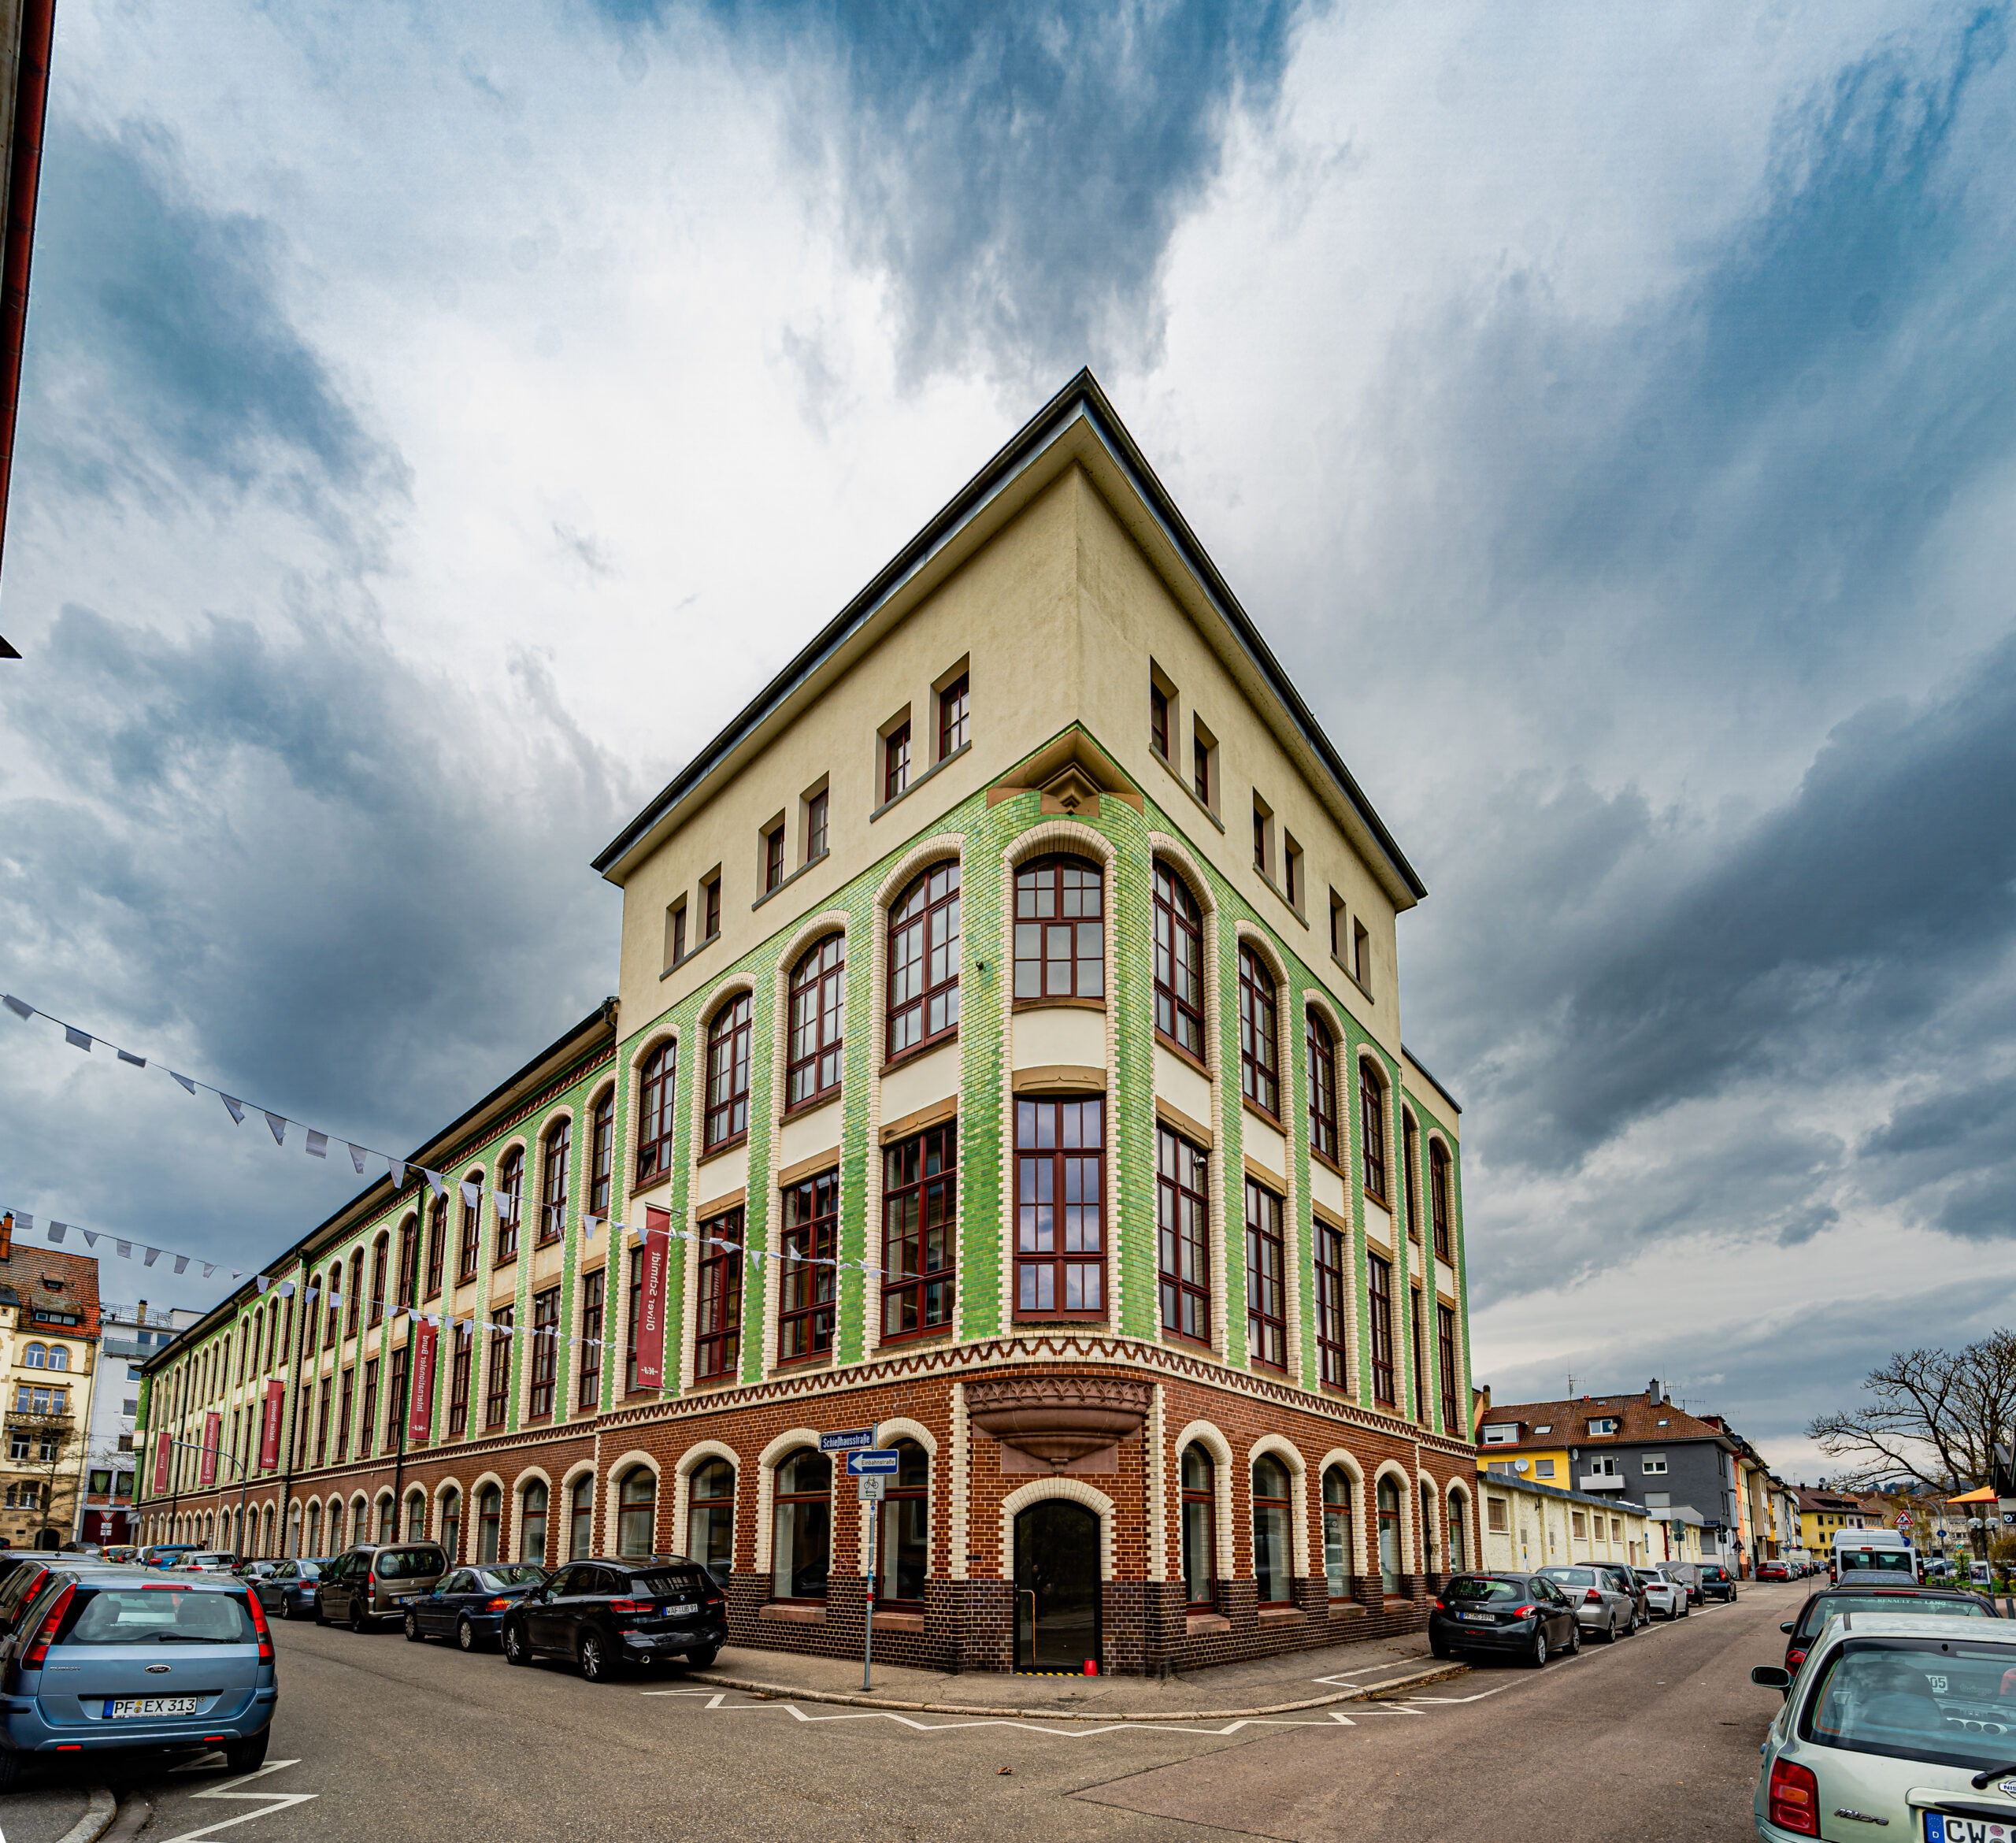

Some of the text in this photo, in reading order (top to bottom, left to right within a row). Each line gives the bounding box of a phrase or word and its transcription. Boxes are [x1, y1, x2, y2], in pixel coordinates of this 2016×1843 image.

[823, 1433, 870, 1448] Schießhausstraße
[114, 1701, 135, 1714] PF
[144, 1700, 165, 1712] EX
[168, 1699, 195, 1711] 313
[1946, 1819, 1986, 1843] CW
